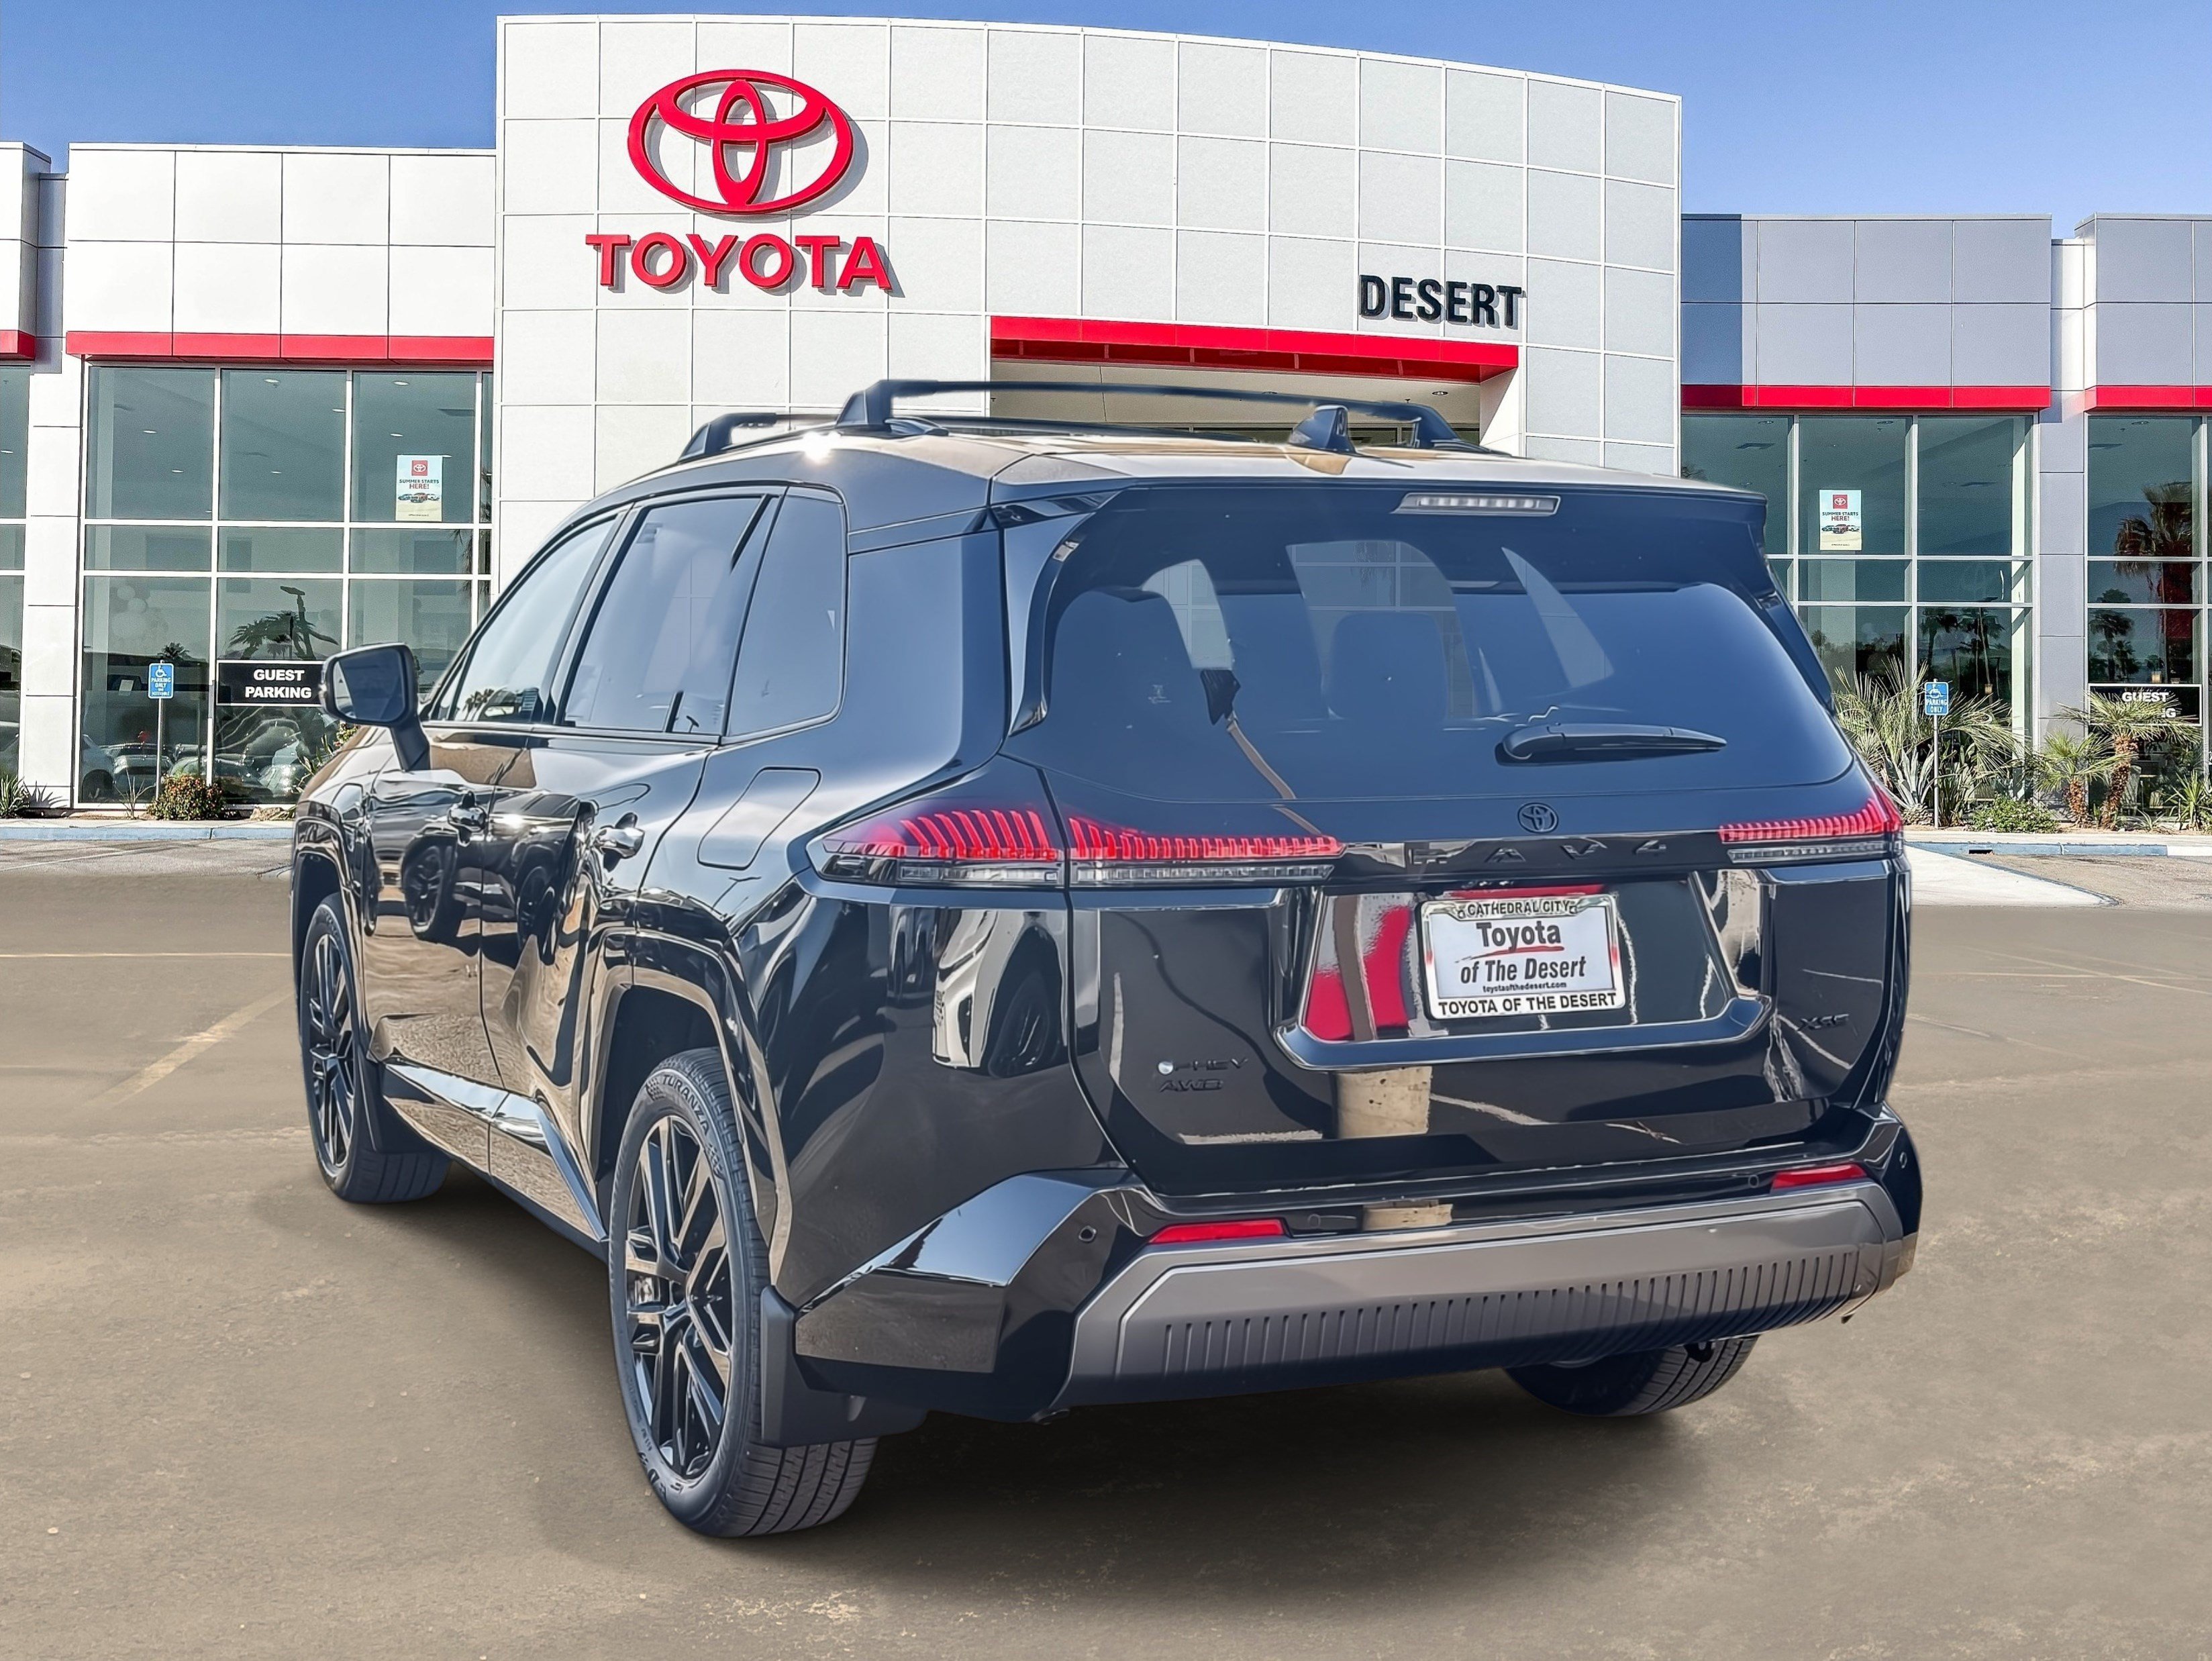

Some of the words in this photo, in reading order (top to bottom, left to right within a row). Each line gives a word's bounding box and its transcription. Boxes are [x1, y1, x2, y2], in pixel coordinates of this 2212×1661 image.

[585, 232, 892, 290] TOYOTA
[1359, 274, 1522, 327] DESERT
[253, 668, 305, 681] GUEST
[245, 686, 312, 699] PARKING
[2121, 691, 2170, 703] GUEST
[1468, 901, 1539, 916] CATHEDRAL
[1543, 900, 1570, 913] CITY
[1476, 921, 1561, 952] Toyota
[1460, 961, 1479, 984] of
[1485, 959, 1517, 982] The
[1524, 956, 1587, 980] Desert
[1482, 982, 1567, 994] toyotaofthedesert.com
[1438, 999, 1497, 1015] TOYOTA
[1503, 998, 1522, 1011] OF
[1526, 996, 1556, 1010] THE
[1560, 993, 1617, 1009] DESERT
[662, 1074, 709, 1136] TURANZA
